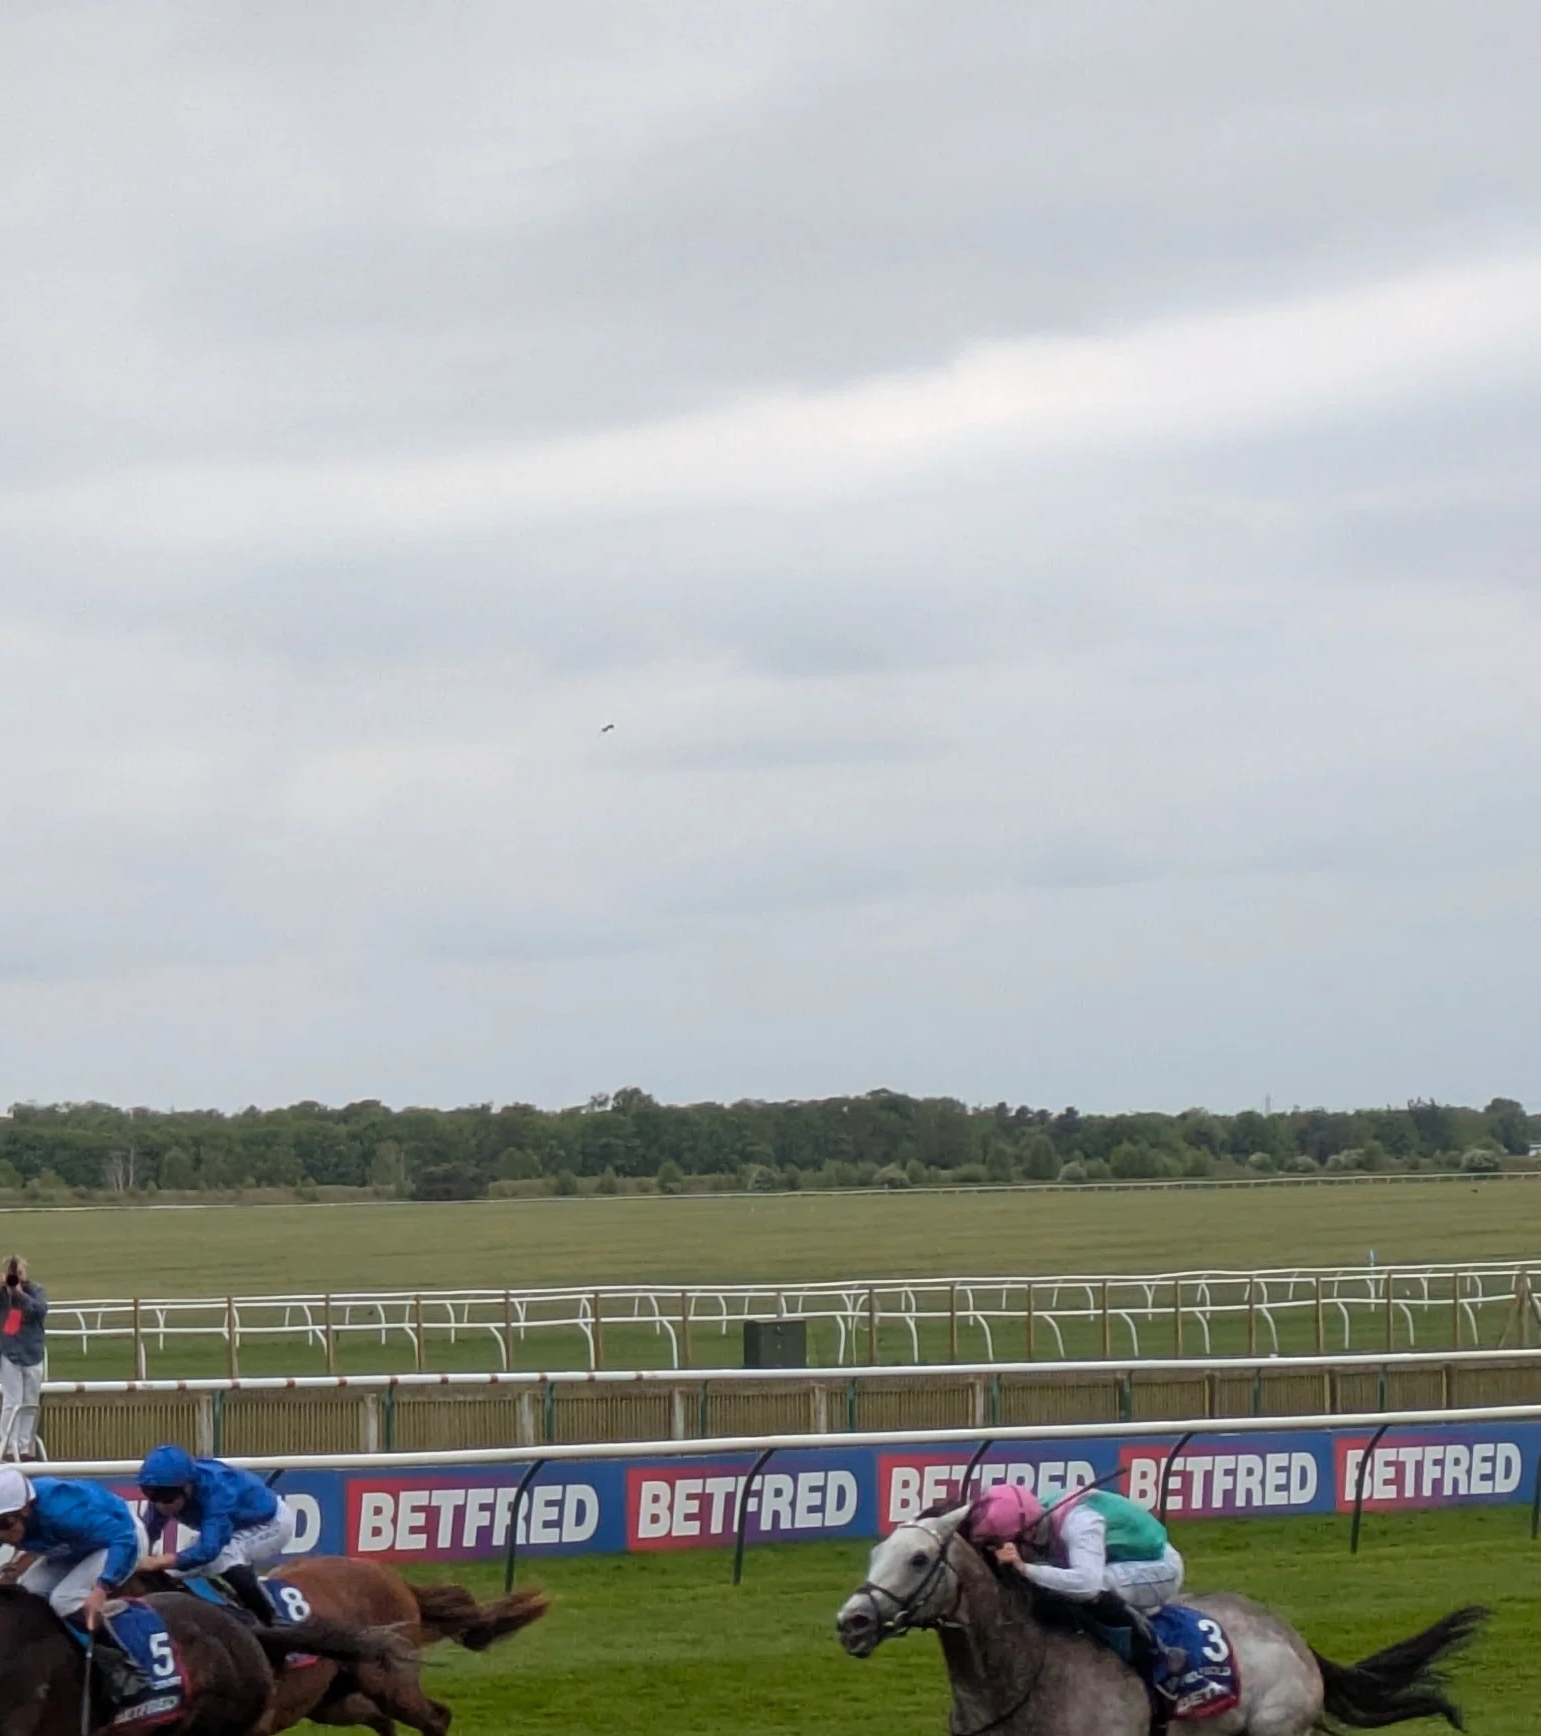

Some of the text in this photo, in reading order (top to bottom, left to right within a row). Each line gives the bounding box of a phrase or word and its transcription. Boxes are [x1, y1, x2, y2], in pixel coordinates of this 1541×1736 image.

[1129, 1451, 1317, 1512] BETFRED
[1344, 1442, 1522, 1500] BETFRED
[357, 1484, 600, 1552] BETFRED
[637, 1470, 858, 1539] BETFRED
[280, 1586, 312, 1622] 8
[149, 1631, 174, 1677] 5
[1198, 1619, 1229, 1662] 3
